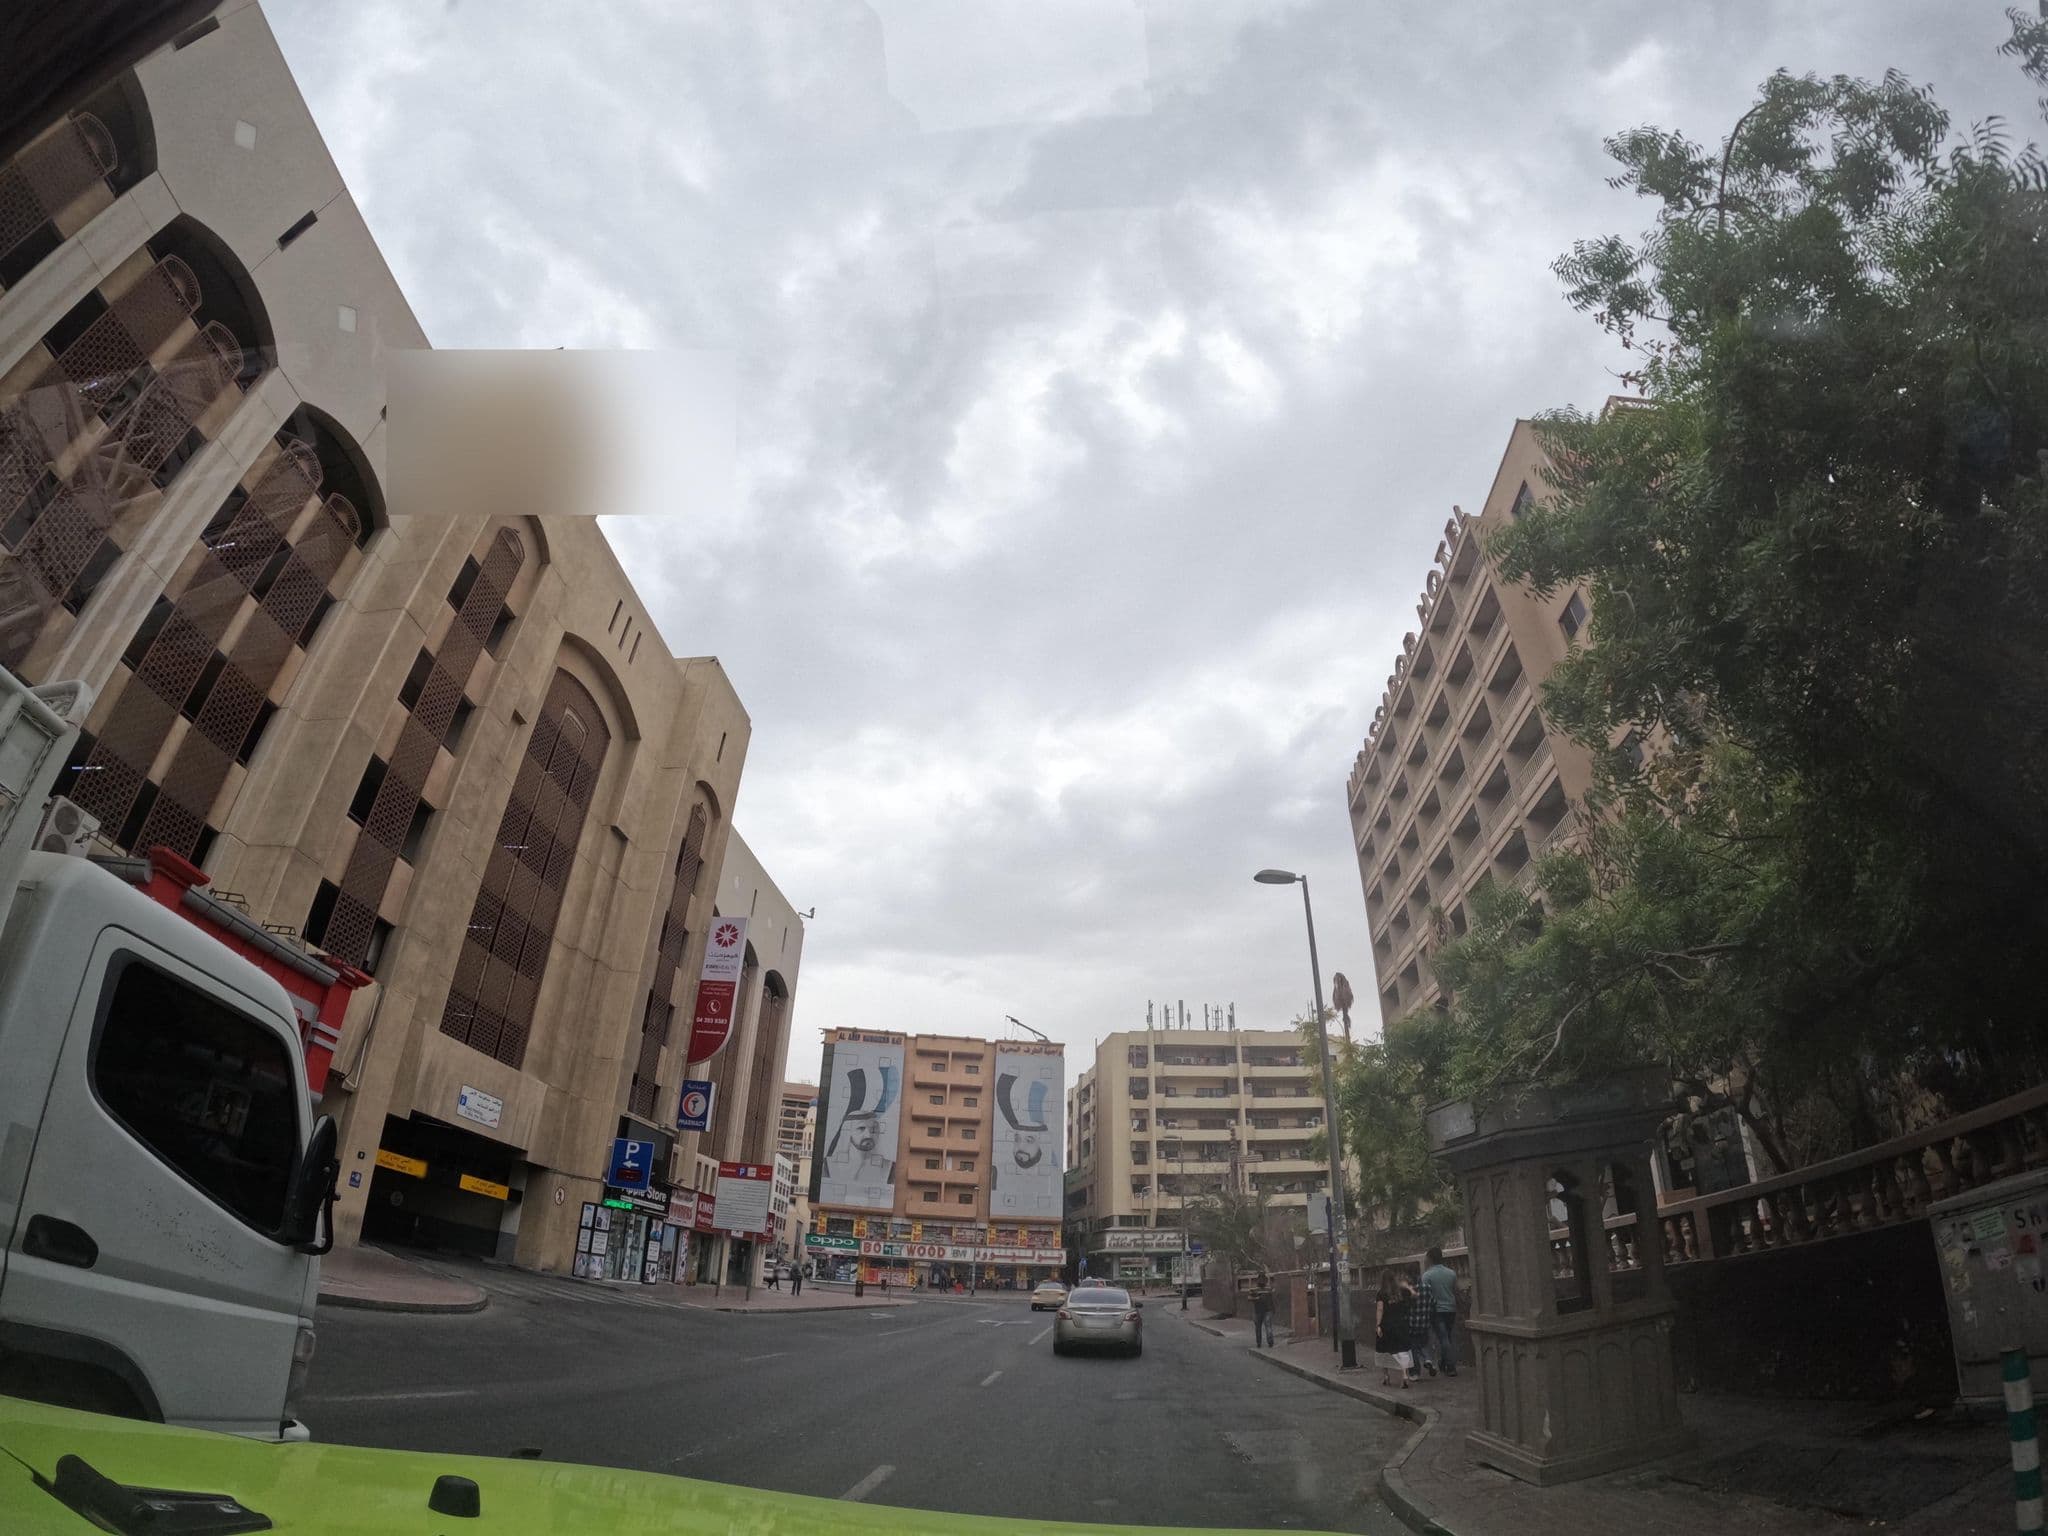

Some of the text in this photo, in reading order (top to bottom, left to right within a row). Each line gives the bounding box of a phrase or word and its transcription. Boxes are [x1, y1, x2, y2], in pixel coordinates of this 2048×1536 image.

[678, 1119, 706, 1127] PHARMACY
[625, 1142, 640, 1160] P
[646, 1185, 667, 1203] Store
[698, 1200, 714, 1215] KIMS
[810, 1236, 855, 1247] oppo
